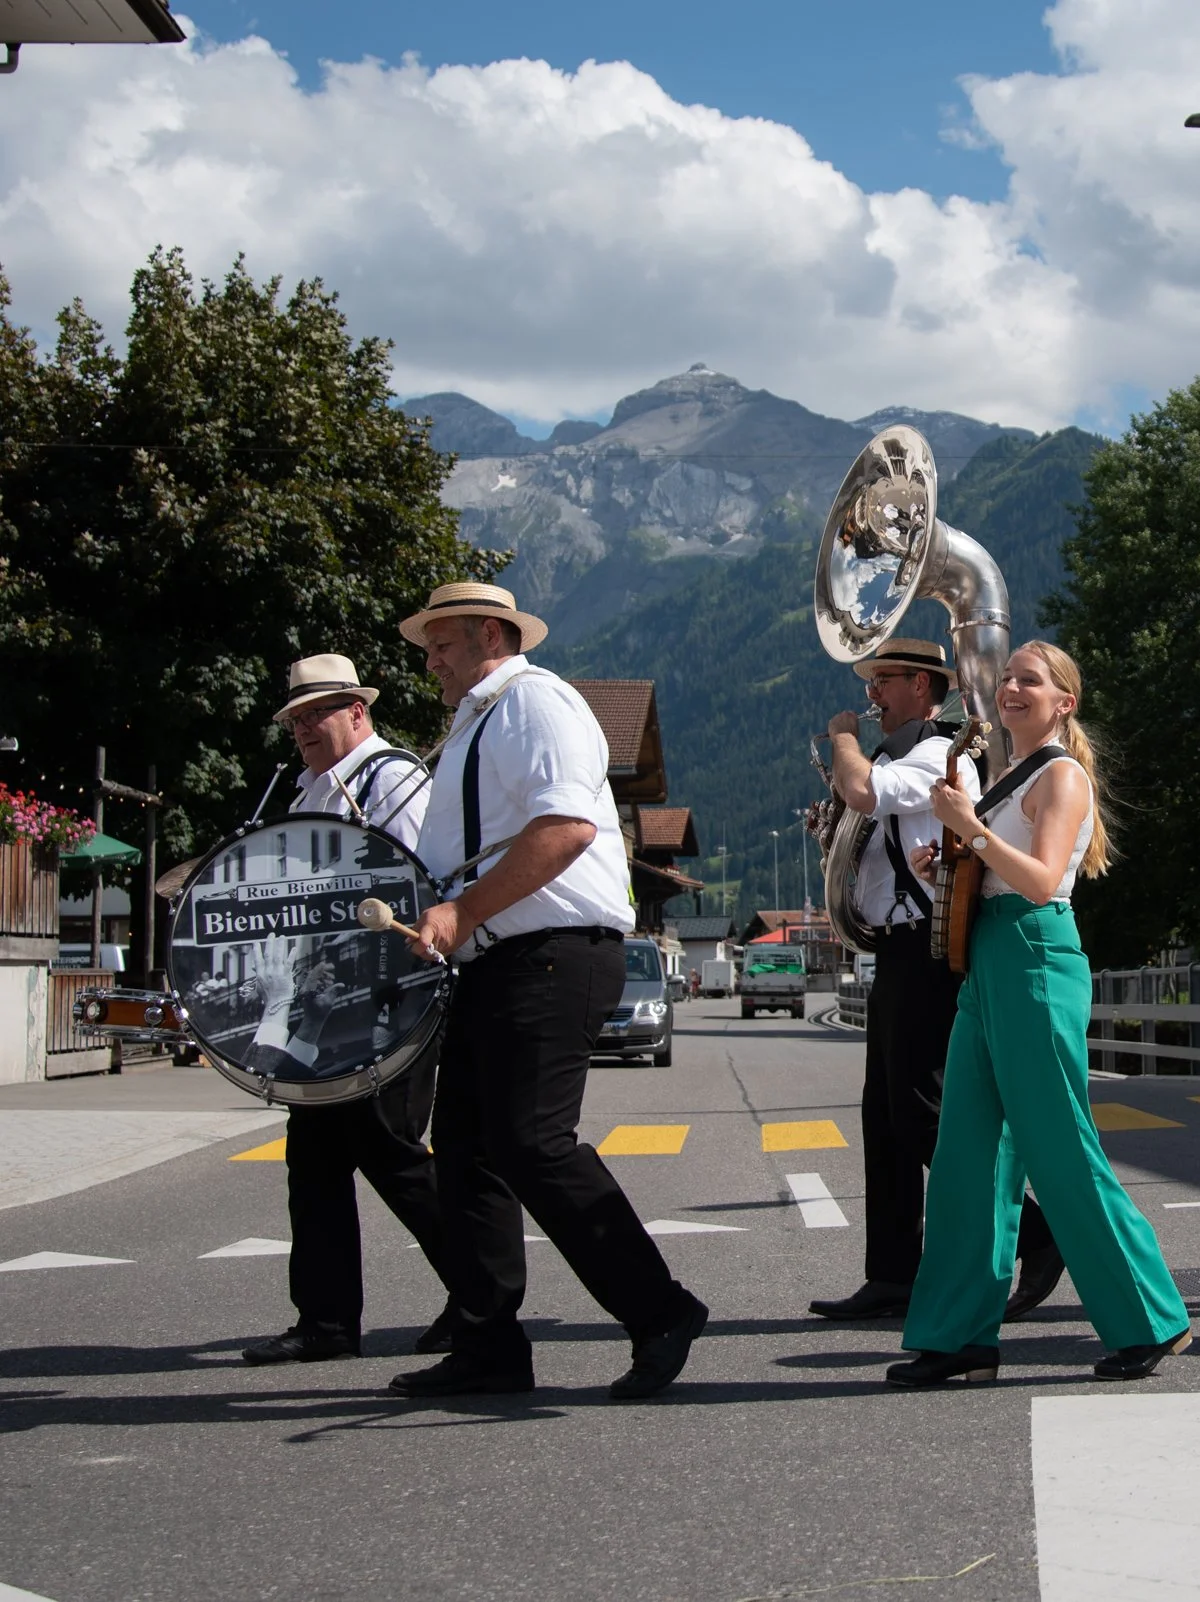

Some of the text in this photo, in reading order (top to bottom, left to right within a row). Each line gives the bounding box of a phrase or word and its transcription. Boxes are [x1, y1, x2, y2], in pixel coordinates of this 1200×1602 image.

[246, 877, 364, 899] Rue Bienville
[204, 896, 410, 935] Bienville Stet
